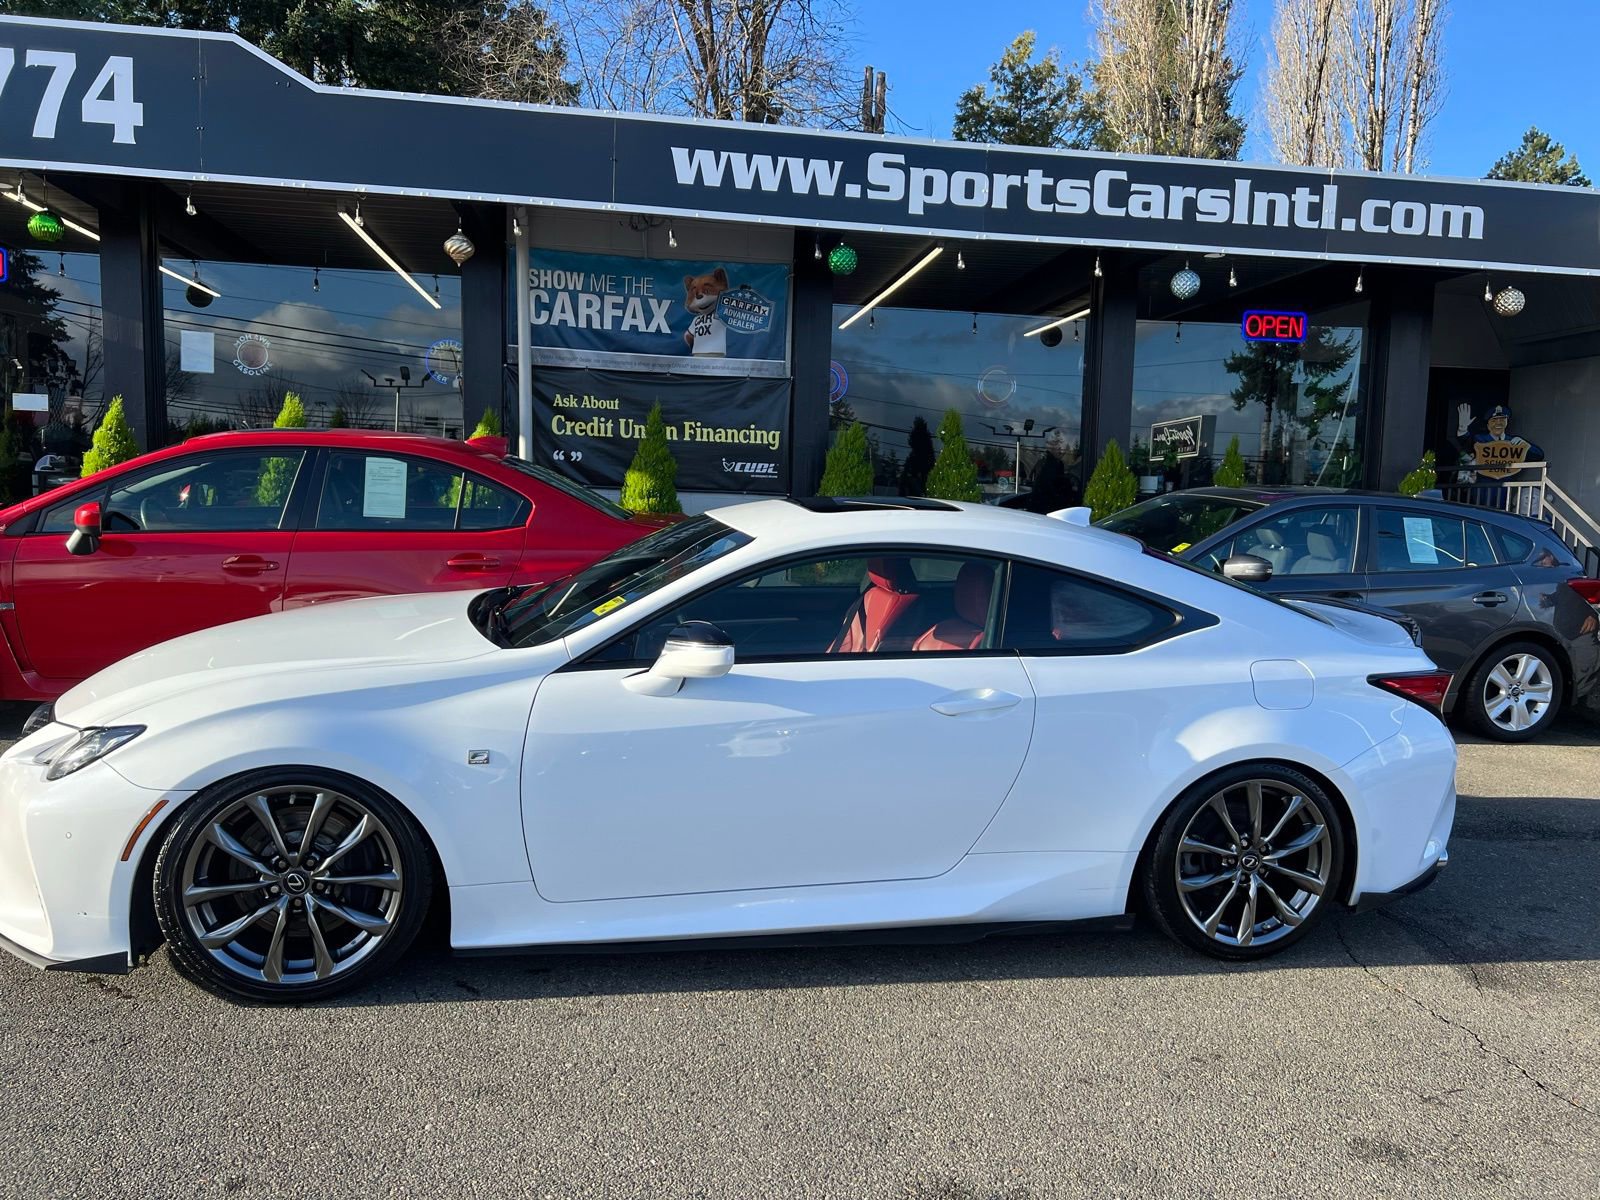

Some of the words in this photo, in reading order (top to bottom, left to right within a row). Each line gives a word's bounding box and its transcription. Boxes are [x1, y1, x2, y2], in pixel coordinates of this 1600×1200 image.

[671, 146, 1485, 240] www.SportsCarsIntl.com
[529, 268, 584, 291] SHOW
[590, 273, 616, 293] ME
[622, 275, 654, 296] THE
[529, 288, 672, 334] CARFAX
[721, 297, 769, 316] CARFAX
[694, 313, 713, 326] CAR
[723, 308, 764, 324] ADVANTAGE
[727, 317, 755, 331] DEALER
[694, 324, 712, 337] FOX
[1245, 314, 1303, 338] OPEN
[553, 394, 578, 408] Ask
[580, 395, 620, 410] About
[551, 414, 614, 438] Credit
[618, 418, 679, 441] Unn
[683, 421, 781, 450] Financing
[1482, 446, 1524, 459] SLOW
